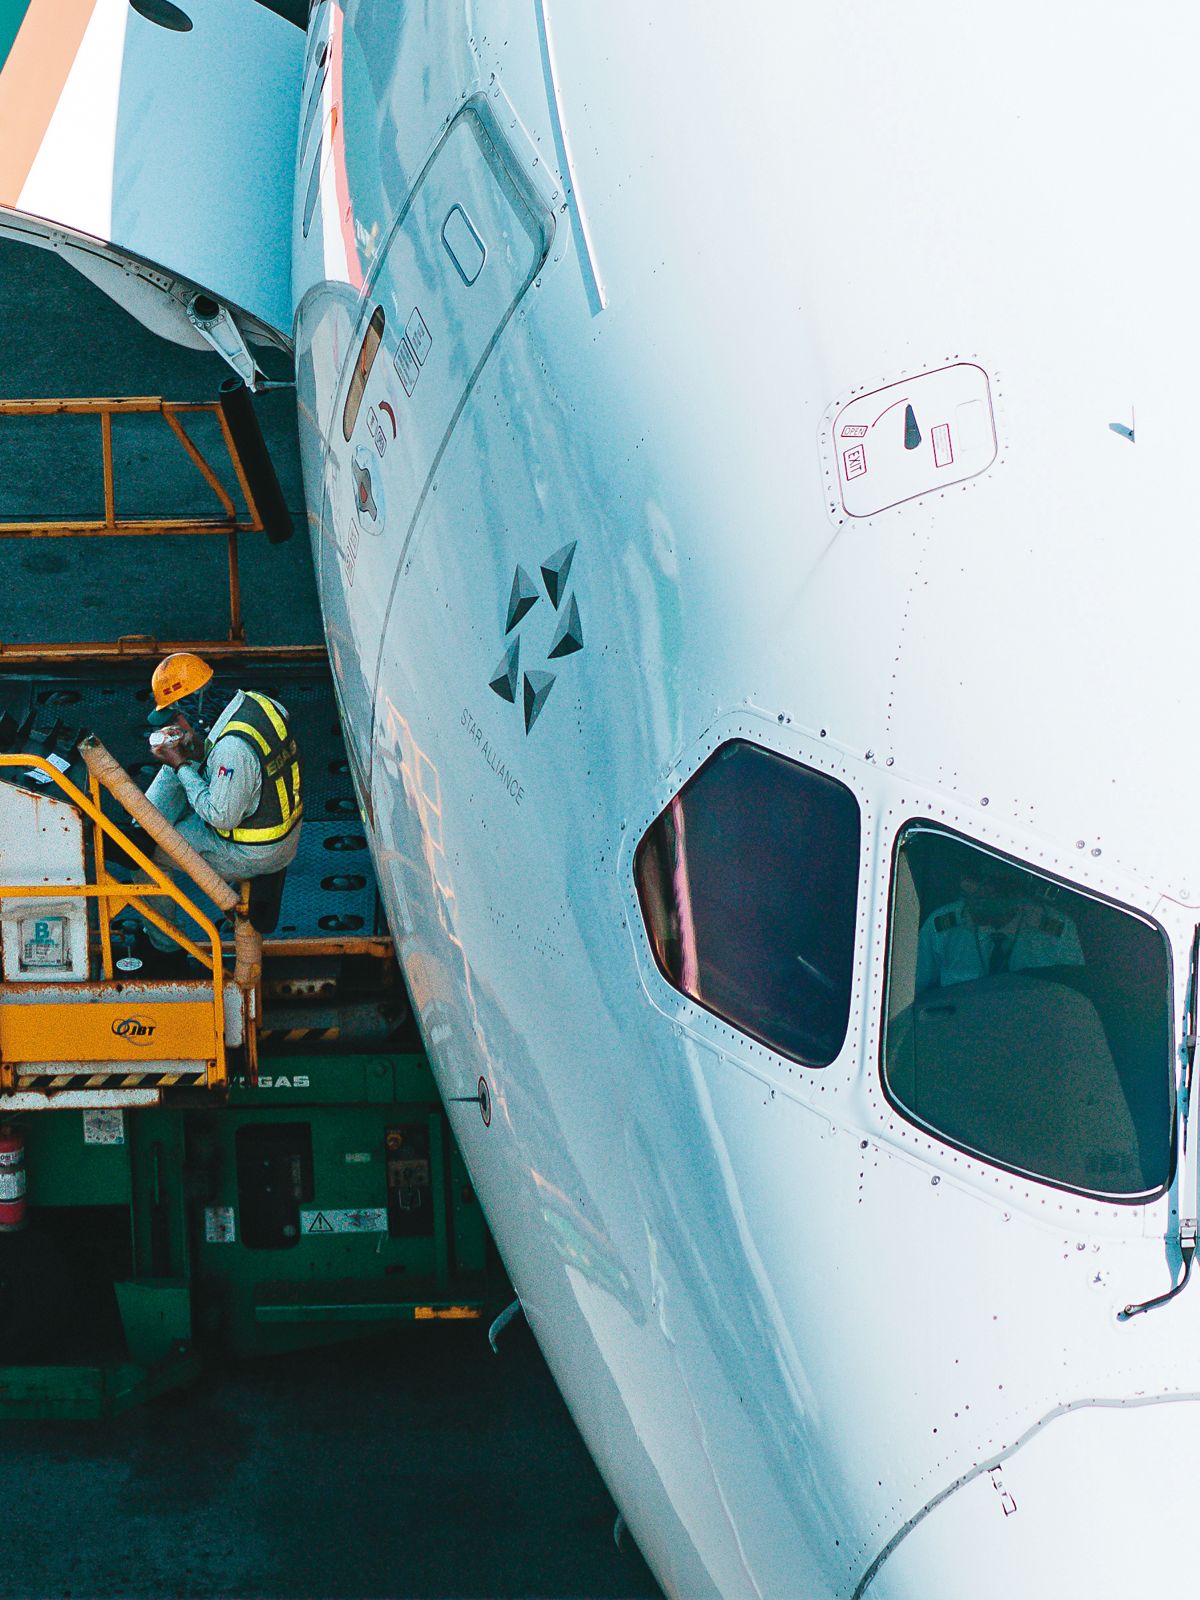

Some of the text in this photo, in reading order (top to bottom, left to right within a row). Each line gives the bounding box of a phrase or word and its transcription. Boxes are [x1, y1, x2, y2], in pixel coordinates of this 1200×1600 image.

[844, 427, 865, 436] OPEN
[848, 450, 862, 473] EXIT
[460, 708, 525, 806] STAR ALLIANCE
[35, 921, 50, 940] B
[129, 1025, 157, 1036] JBT
